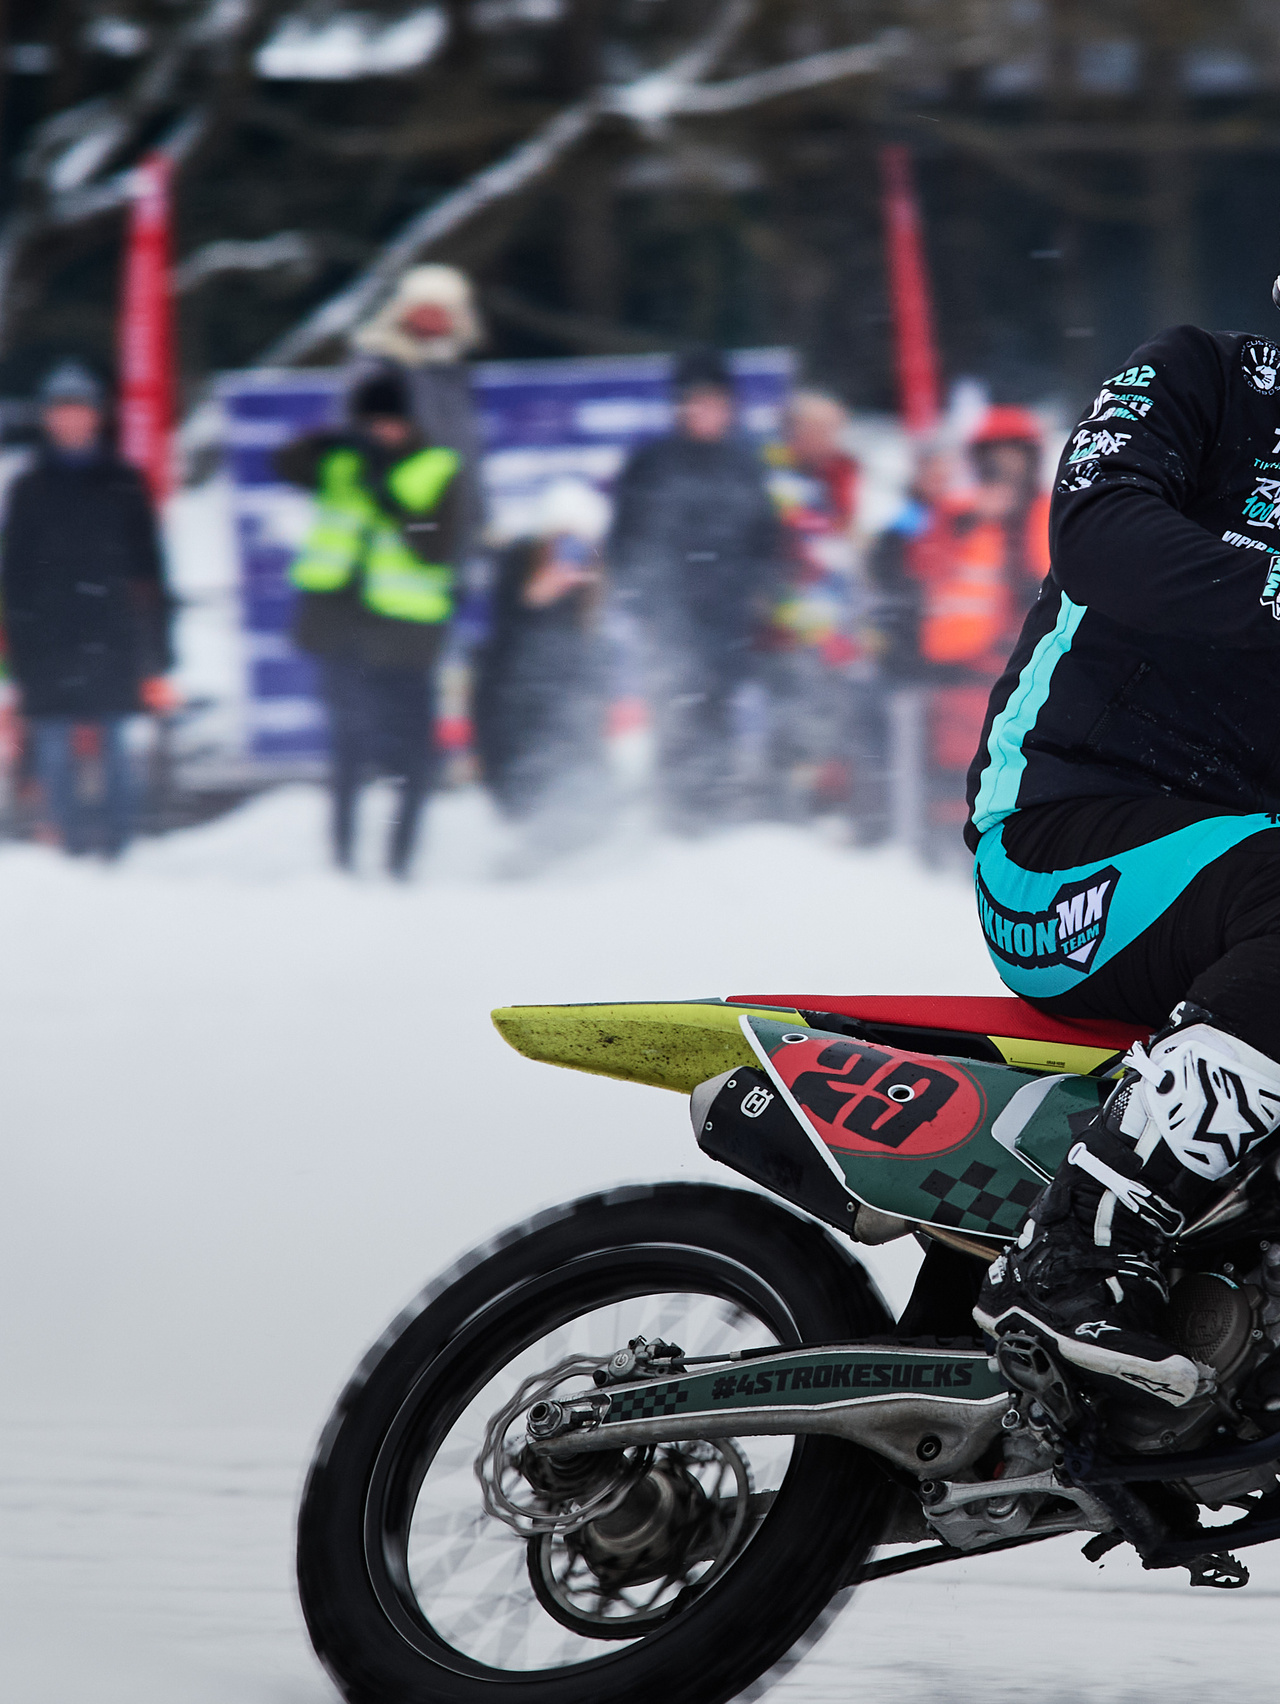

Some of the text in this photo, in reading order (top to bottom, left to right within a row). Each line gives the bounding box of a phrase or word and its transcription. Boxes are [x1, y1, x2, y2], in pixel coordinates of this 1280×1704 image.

[1056, 879, 1111, 940] MX
[1060, 923, 1100, 955] TEAM
[787, 1041, 960, 1149] 29
[712, 1362, 975, 1400] #4STROKESUCKS
